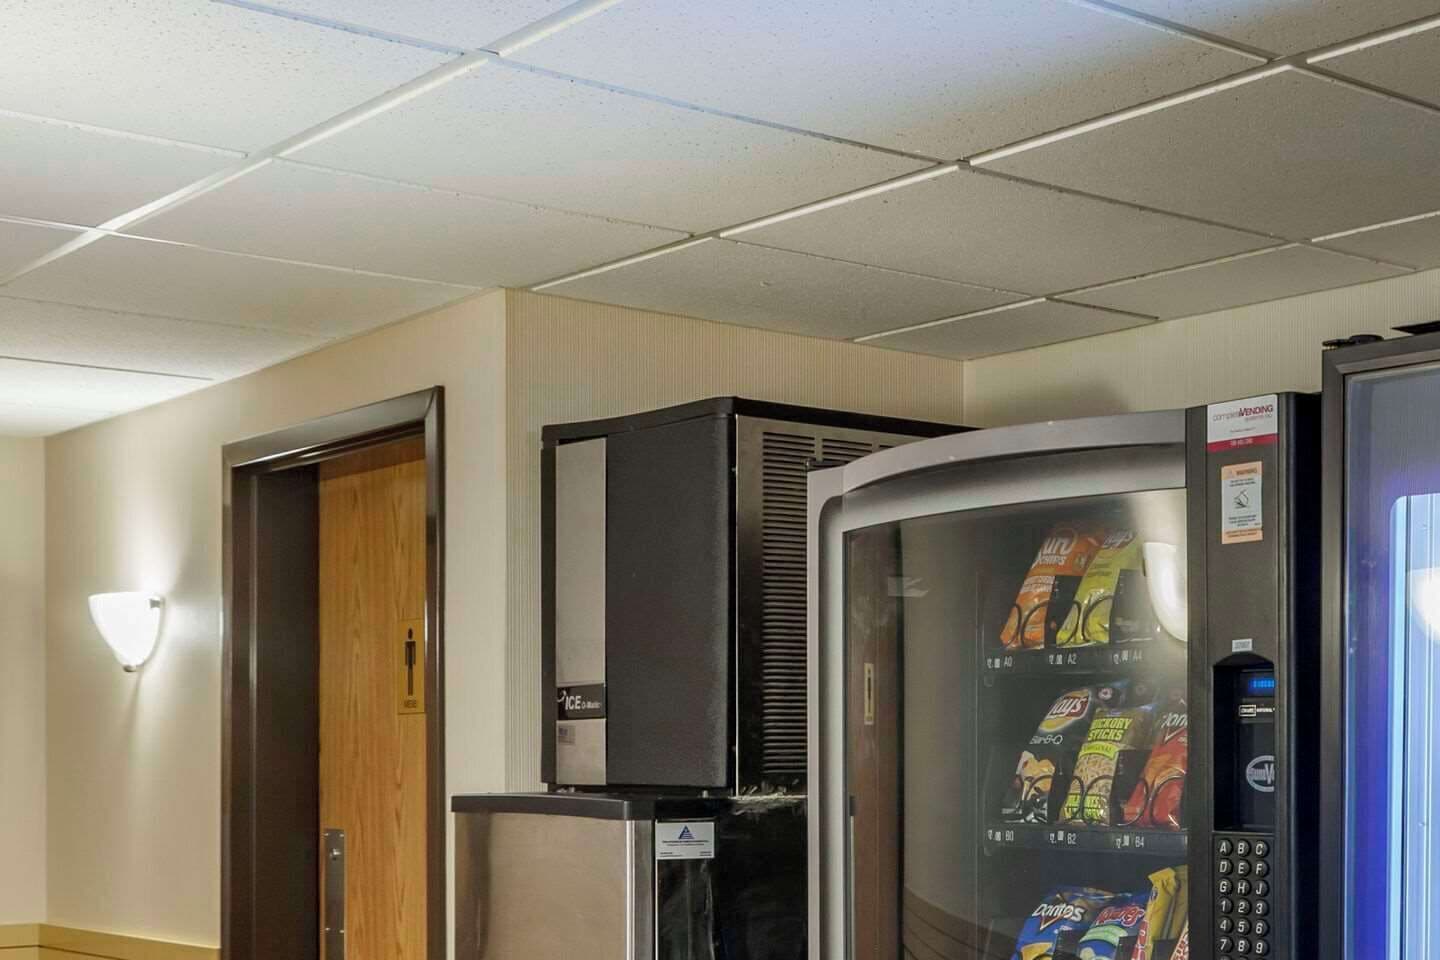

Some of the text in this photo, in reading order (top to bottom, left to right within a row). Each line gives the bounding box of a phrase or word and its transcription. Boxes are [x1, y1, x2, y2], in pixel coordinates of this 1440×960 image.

[1004, 656, 1012, 667] A0
[1067, 653, 1077, 665] A2
[565, 695, 581, 710] ICE
[1088, 730, 1124, 741] STICKS
[1220, 842, 1263, 855] A B C
[1220, 861, 1262, 875] D E F
[1220, 881, 1262, 895] G H J
[1032, 903, 1086, 922] Doritos
[1221, 901, 1263, 914] 1 2 3
[1220, 920, 1263, 934] 4 5 6
[1220, 939, 1263, 954] 7 8 9
